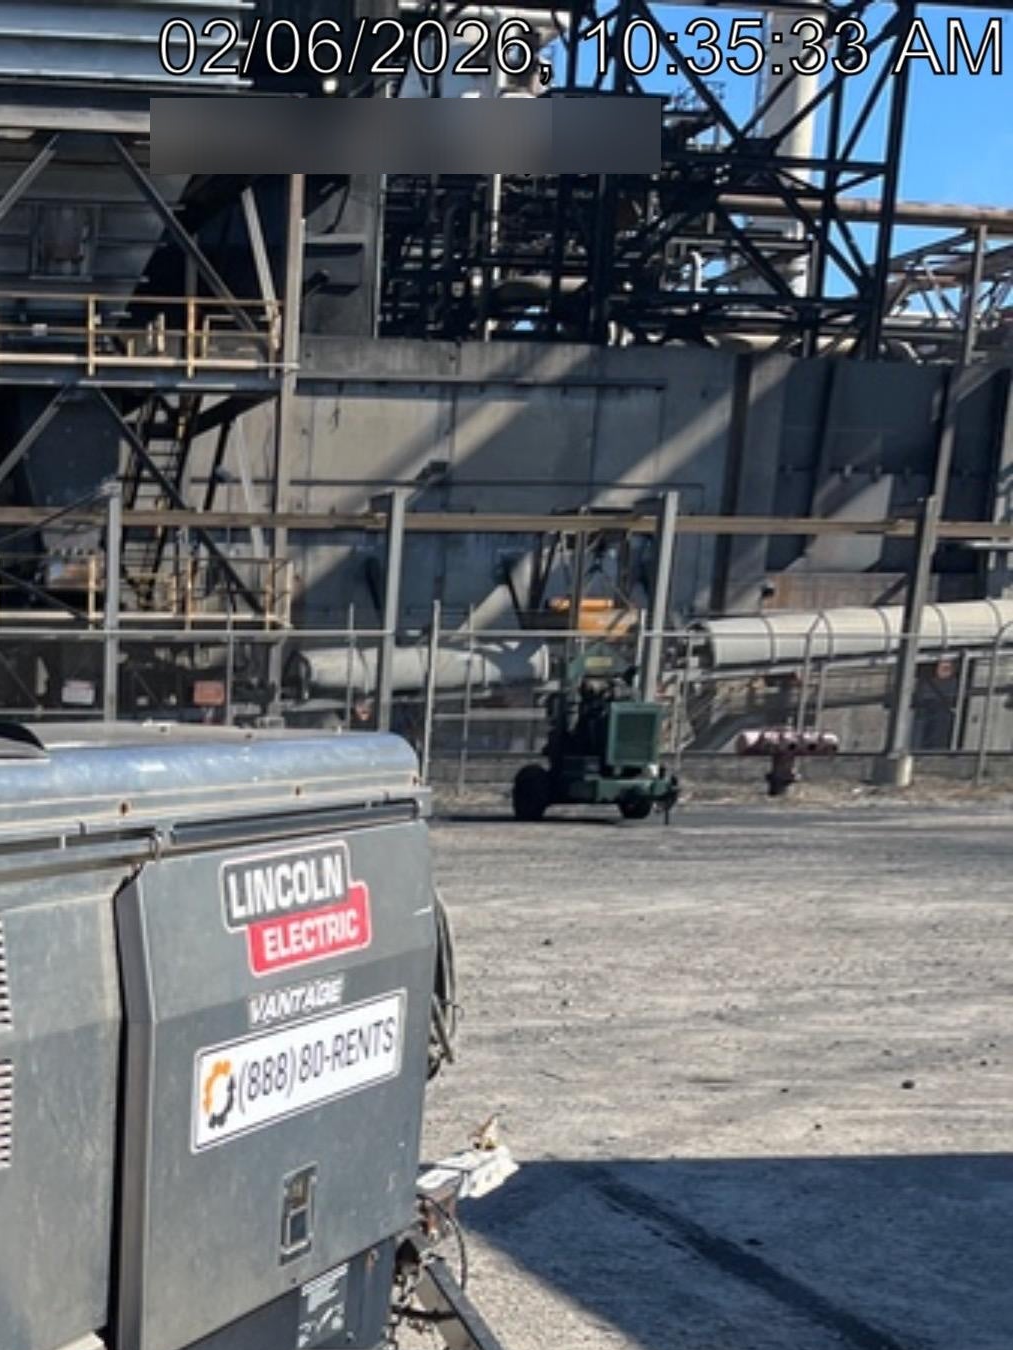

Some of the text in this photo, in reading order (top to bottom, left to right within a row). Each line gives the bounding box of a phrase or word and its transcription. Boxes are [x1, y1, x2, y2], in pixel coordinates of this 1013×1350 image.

[228, 854, 344, 919] LINCOLN
[262, 908, 360, 962] ELECTRIC
[250, 977, 343, 1026] VANTAGE
